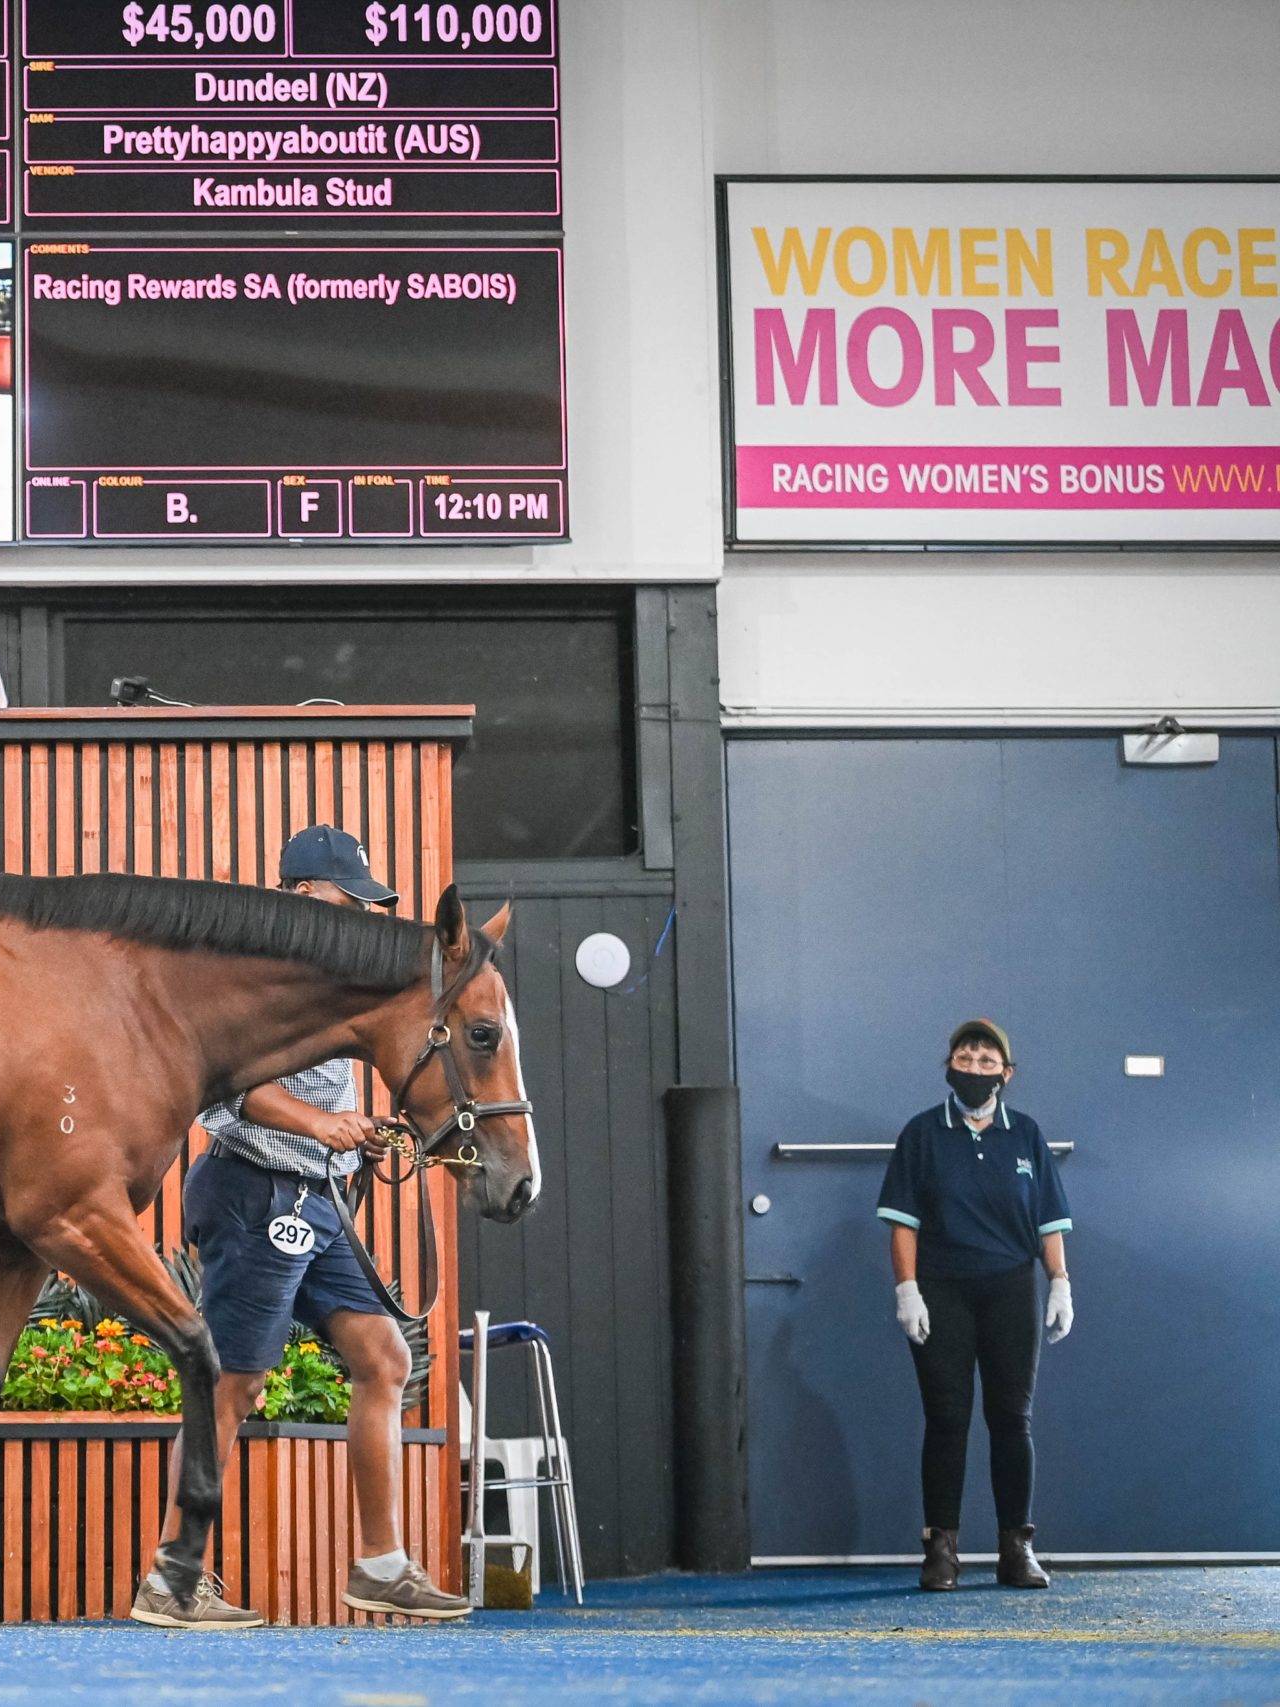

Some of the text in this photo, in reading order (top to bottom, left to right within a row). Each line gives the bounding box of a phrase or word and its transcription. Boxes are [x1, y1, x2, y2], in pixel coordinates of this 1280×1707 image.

[122, 2, 275, 49] $45,000
[366, 2, 541, 49] $110,000
[29, 62, 55, 71] SIRE
[196, 72, 387, 107] Dundeel (NZ)
[30, 114, 54, 123] DAM
[104, 124, 480, 159] Prettyhappyaboutit (AUS)
[29, 166, 75, 175] VENDOR
[194, 177, 392, 206] Kambula Stud
[29, 244, 89, 254] COMMENTS
[752, 227, 1278, 298] WOMEN RACE
[34, 273, 516, 305] Racing Rewards SA (formerly SABOIS)
[754, 307, 1280, 407] MORE MA
[31, 476, 70, 486] ONLINE
[98, 476, 143, 486] COLOUR
[283, 475, 305, 486] SEX
[353, 475, 395, 485] IN FOAL
[425, 475, 451, 485] TIME
[773, 464, 1280, 493] RACING WOMEN'S BONUS WWW.
[167, 493, 197, 523] B.
[301, 492, 319, 522] F
[435, 493, 548, 520] 12:10 PM
[64, 1086, 75, 1103] 3
[273, 1222, 311, 1248] 297
